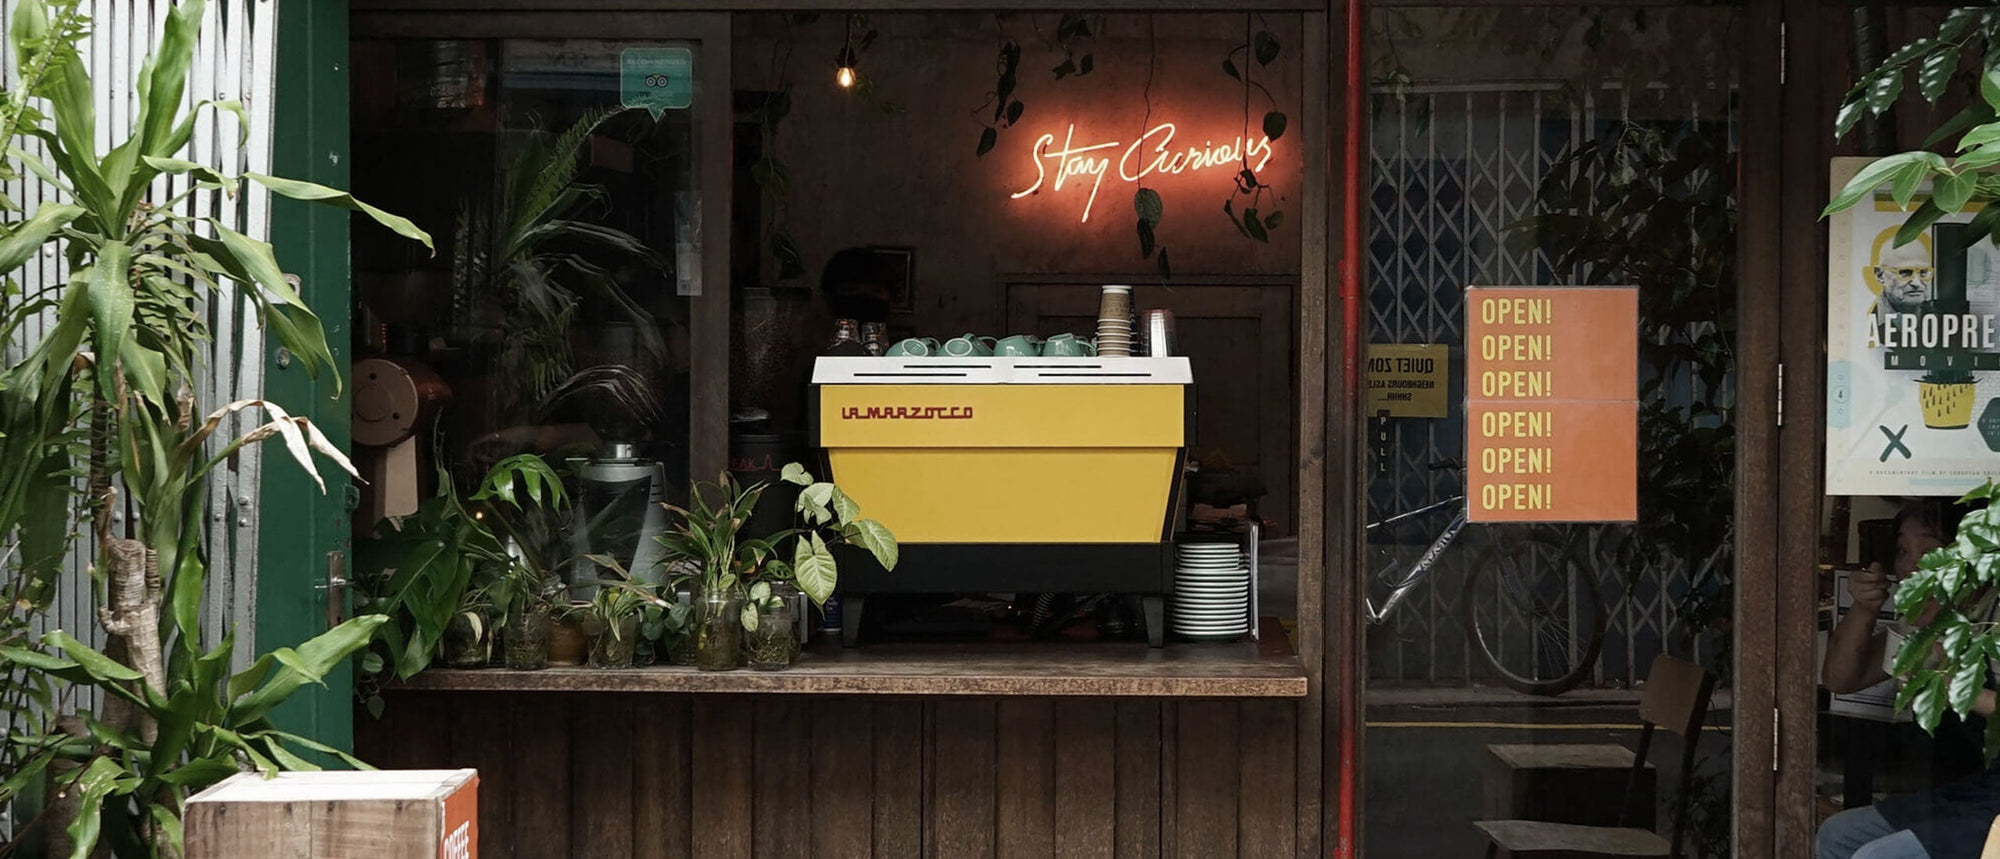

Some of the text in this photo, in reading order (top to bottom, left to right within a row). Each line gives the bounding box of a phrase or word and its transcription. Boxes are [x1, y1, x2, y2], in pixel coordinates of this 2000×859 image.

[1011, 123, 1272, 222] Stay Curious
[1482, 298, 1552, 325] OPEN!
[1865, 313, 2000, 349] AEROPRE
[1482, 334, 1552, 361] OPEN!
[1891, 355, 2000, 367] MOVI
[1482, 371, 1552, 397] OPEN!
[842, 407, 973, 419] LA MARZOCCO
[1482, 411, 1552, 438] OPEN!
[1482, 447, 1552, 474] OPEN!
[1482, 483, 1552, 510] OPEN!
